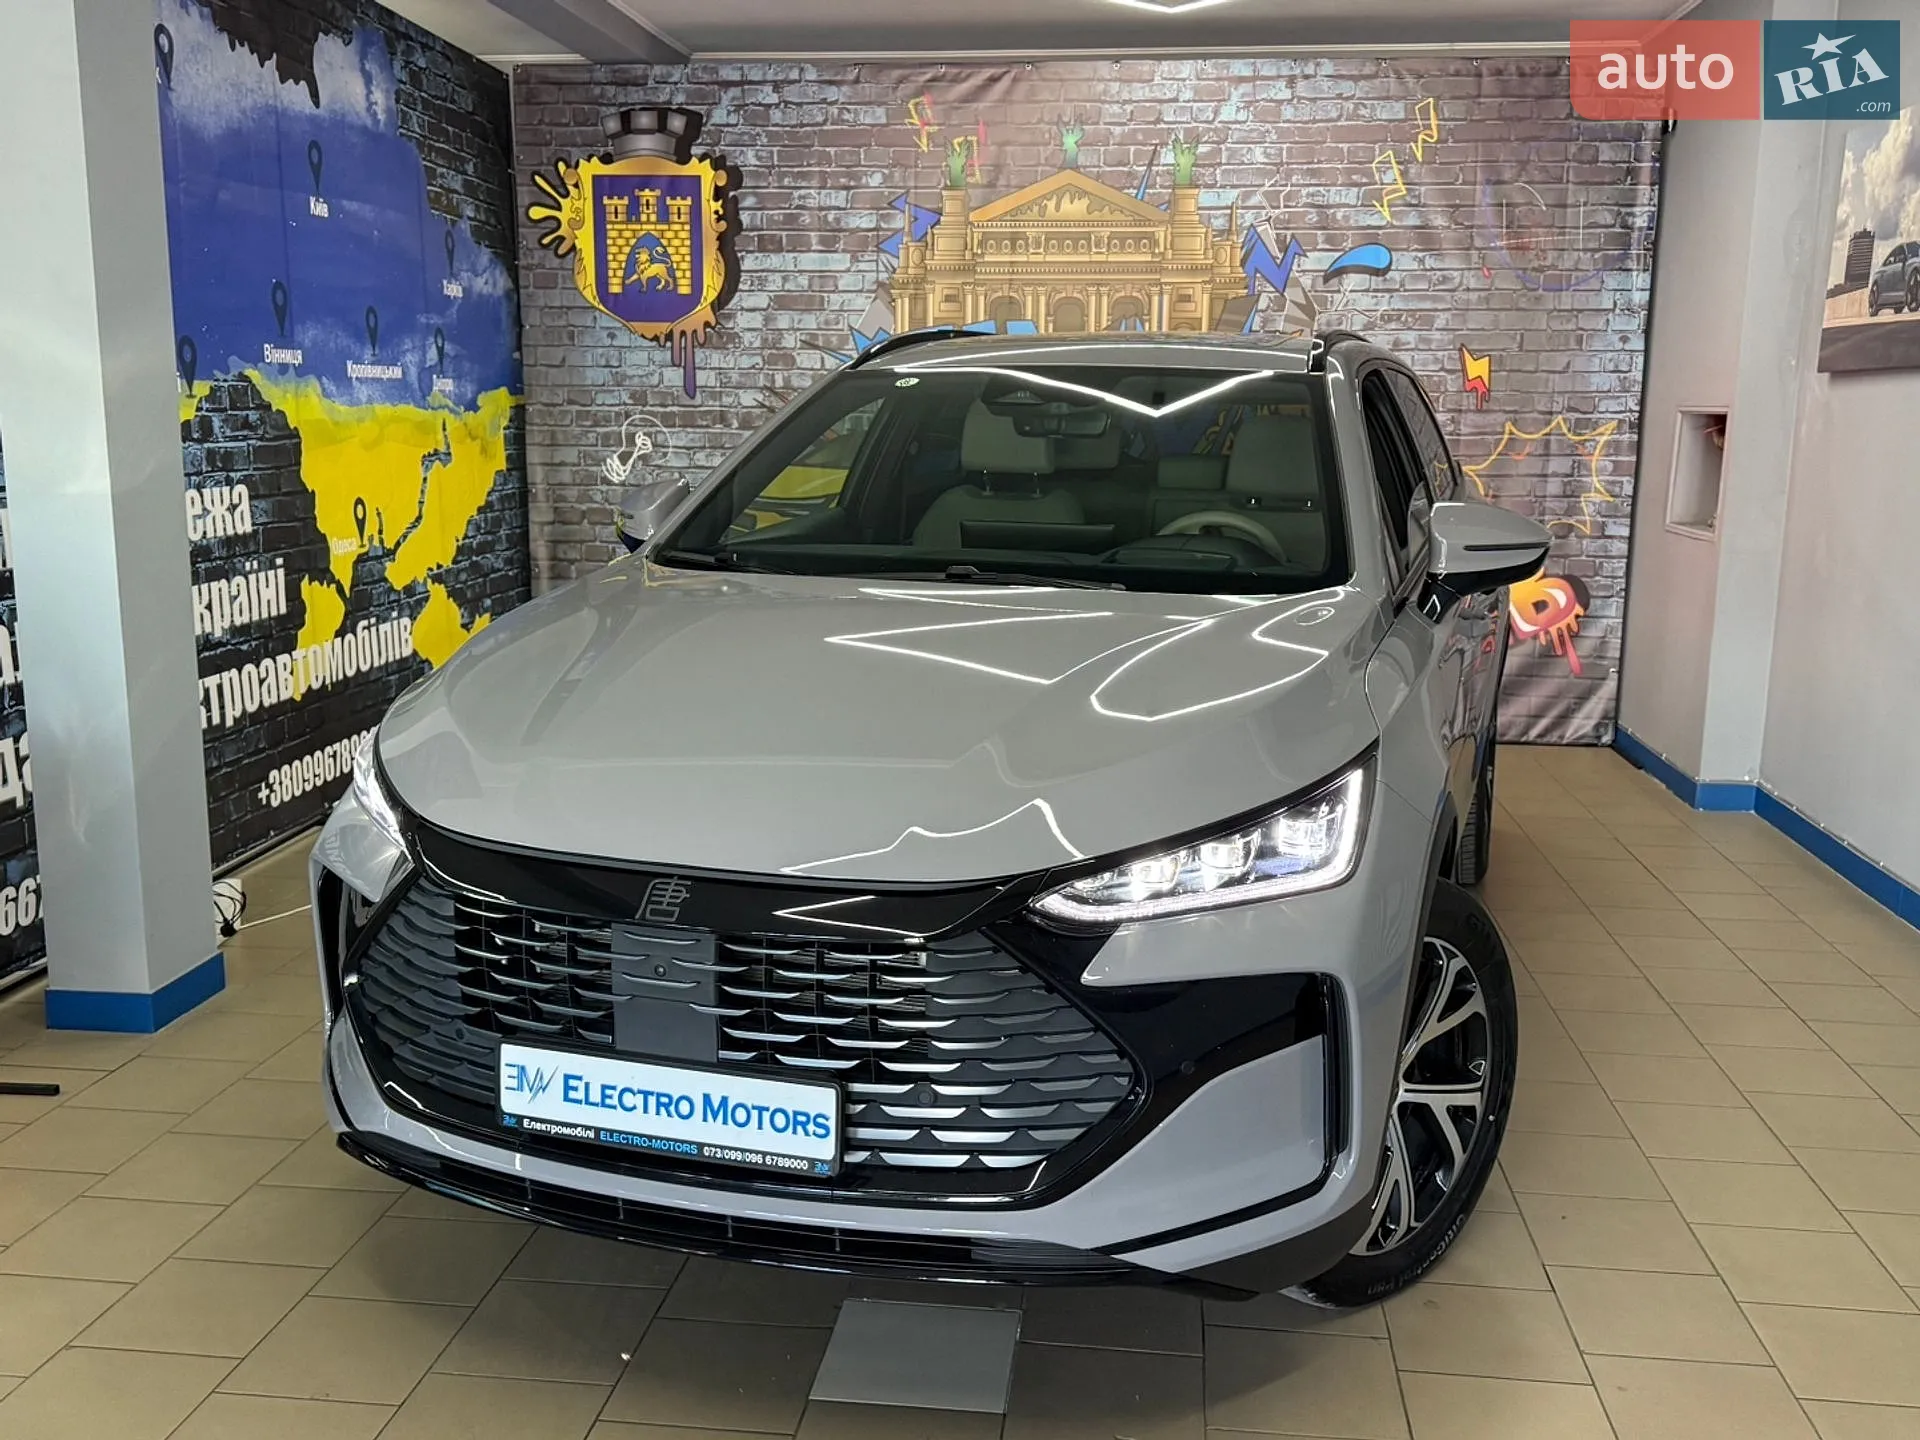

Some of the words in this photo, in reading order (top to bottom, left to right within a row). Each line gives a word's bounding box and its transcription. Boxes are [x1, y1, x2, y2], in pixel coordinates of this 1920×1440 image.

[310, 196, 329, 217] Київ
[263, 343, 303, 366] Вінниця
[184, 483, 252, 541] ежа
[332, 537, 357, 555] Одеса
[563, 1073, 695, 1121] ELECTRO
[702, 1092, 831, 1139] MOTORS
[523, 1118, 595, 1139] Електромобілі
[600, 1130, 698, 1155] ELECTRO-MOTORS
